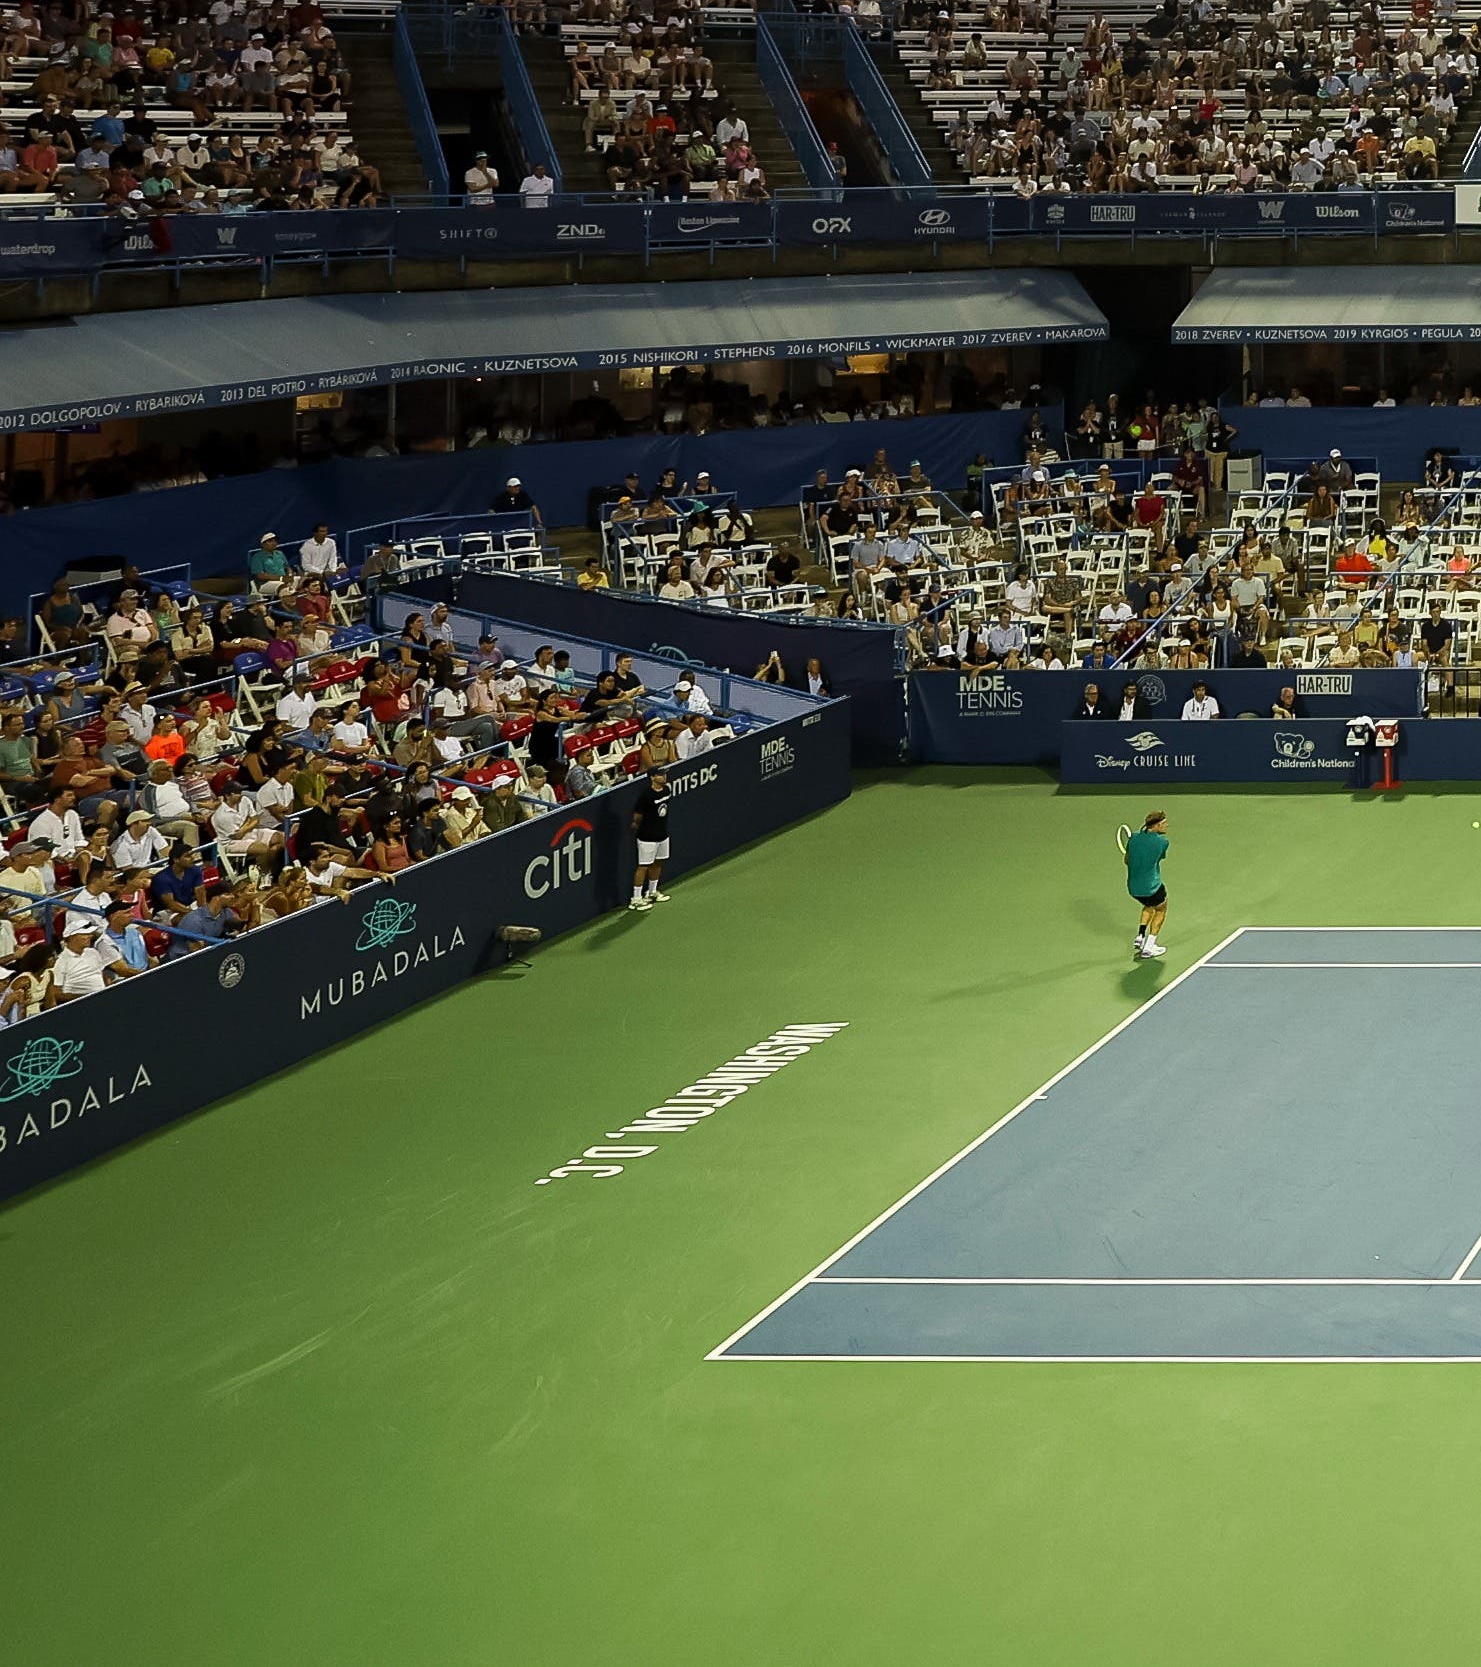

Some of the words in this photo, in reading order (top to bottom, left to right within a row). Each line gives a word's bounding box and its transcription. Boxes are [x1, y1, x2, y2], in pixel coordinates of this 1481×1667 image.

[1091, 206, 1135, 222] HAR-TRU
[1315, 206, 1360, 217] Wilson
[914, 226, 955, 234] HYUNDAI
[1, 243, 55, 255] waterdrop
[1175, 330, 1198, 340] 2018
[1202, 330, 1242, 340] ZVEREV
[1255, 329, 1327, 340] KUZNETSOVA
[1333, 329, 1357, 339] 2019
[1361, 329, 1408, 339] KYRGIOS
[1421, 328, 1463, 338] PEGULA
[0, 415, 25, 429] 2012
[31, 402, 122, 426] DOLGOPOLOV
[221, 388, 243, 403] 2013
[248, 385, 267, 398] DEL
[271, 380, 306, 396] POTRO
[413, 362, 465, 376] RAONIC
[484, 356, 578, 373] KUZNETSOVA
[599, 353, 627, 365] 2015
[633, 350, 698, 364] NISHIKORI
[714, 345, 775, 359] STEPHENS
[787, 344, 813, 355] 2016
[818, 340, 871, 354] MONFILS
[885, 336, 955, 350] WICKMAYER
[962, 334, 986, 345] 2017
[991, 332, 1032, 344] ZVEREV
[1045, 327, 1106, 340] MAKAROVA
[959, 676, 1012, 692] MDE.
[1297, 676, 1350, 694] HAR-TRU
[956, 691, 1024, 709] TENNIS
[761, 736, 790, 759] MDE.
[760, 747, 796, 775] TENNIS
[1094, 754, 1130, 772] Disney
[1133, 755, 1169, 767] CRUISE
[1174, 754, 1196, 767] LINE
[1271, 758, 1316, 769] Children's
[1318, 758, 1355, 769] Nationa
[700, 763, 718, 786] DC
[524, 818, 593, 900] citi
[300, 925, 467, 1020] MUBADALA
[534, 1145, 659, 1185] D.C.
